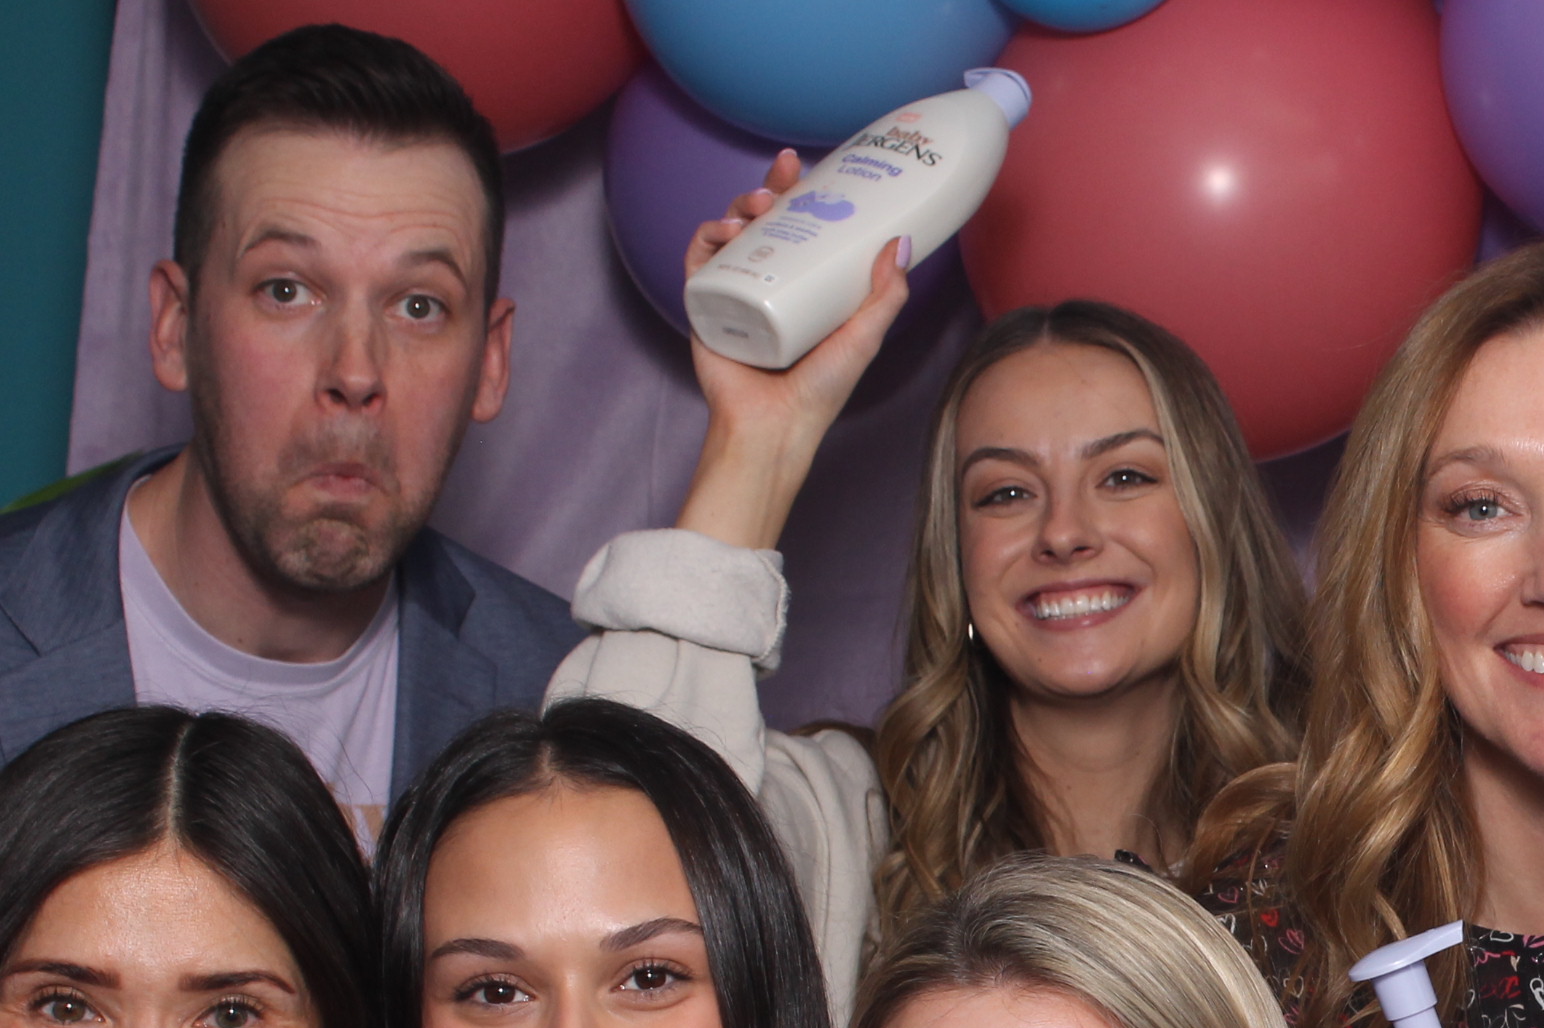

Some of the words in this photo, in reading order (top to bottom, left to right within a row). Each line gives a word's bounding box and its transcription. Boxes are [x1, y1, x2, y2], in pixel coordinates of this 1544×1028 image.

[886, 126, 934, 145] baby
[837, 164, 882, 182] Lotion
[842, 154, 903, 177] Calming
